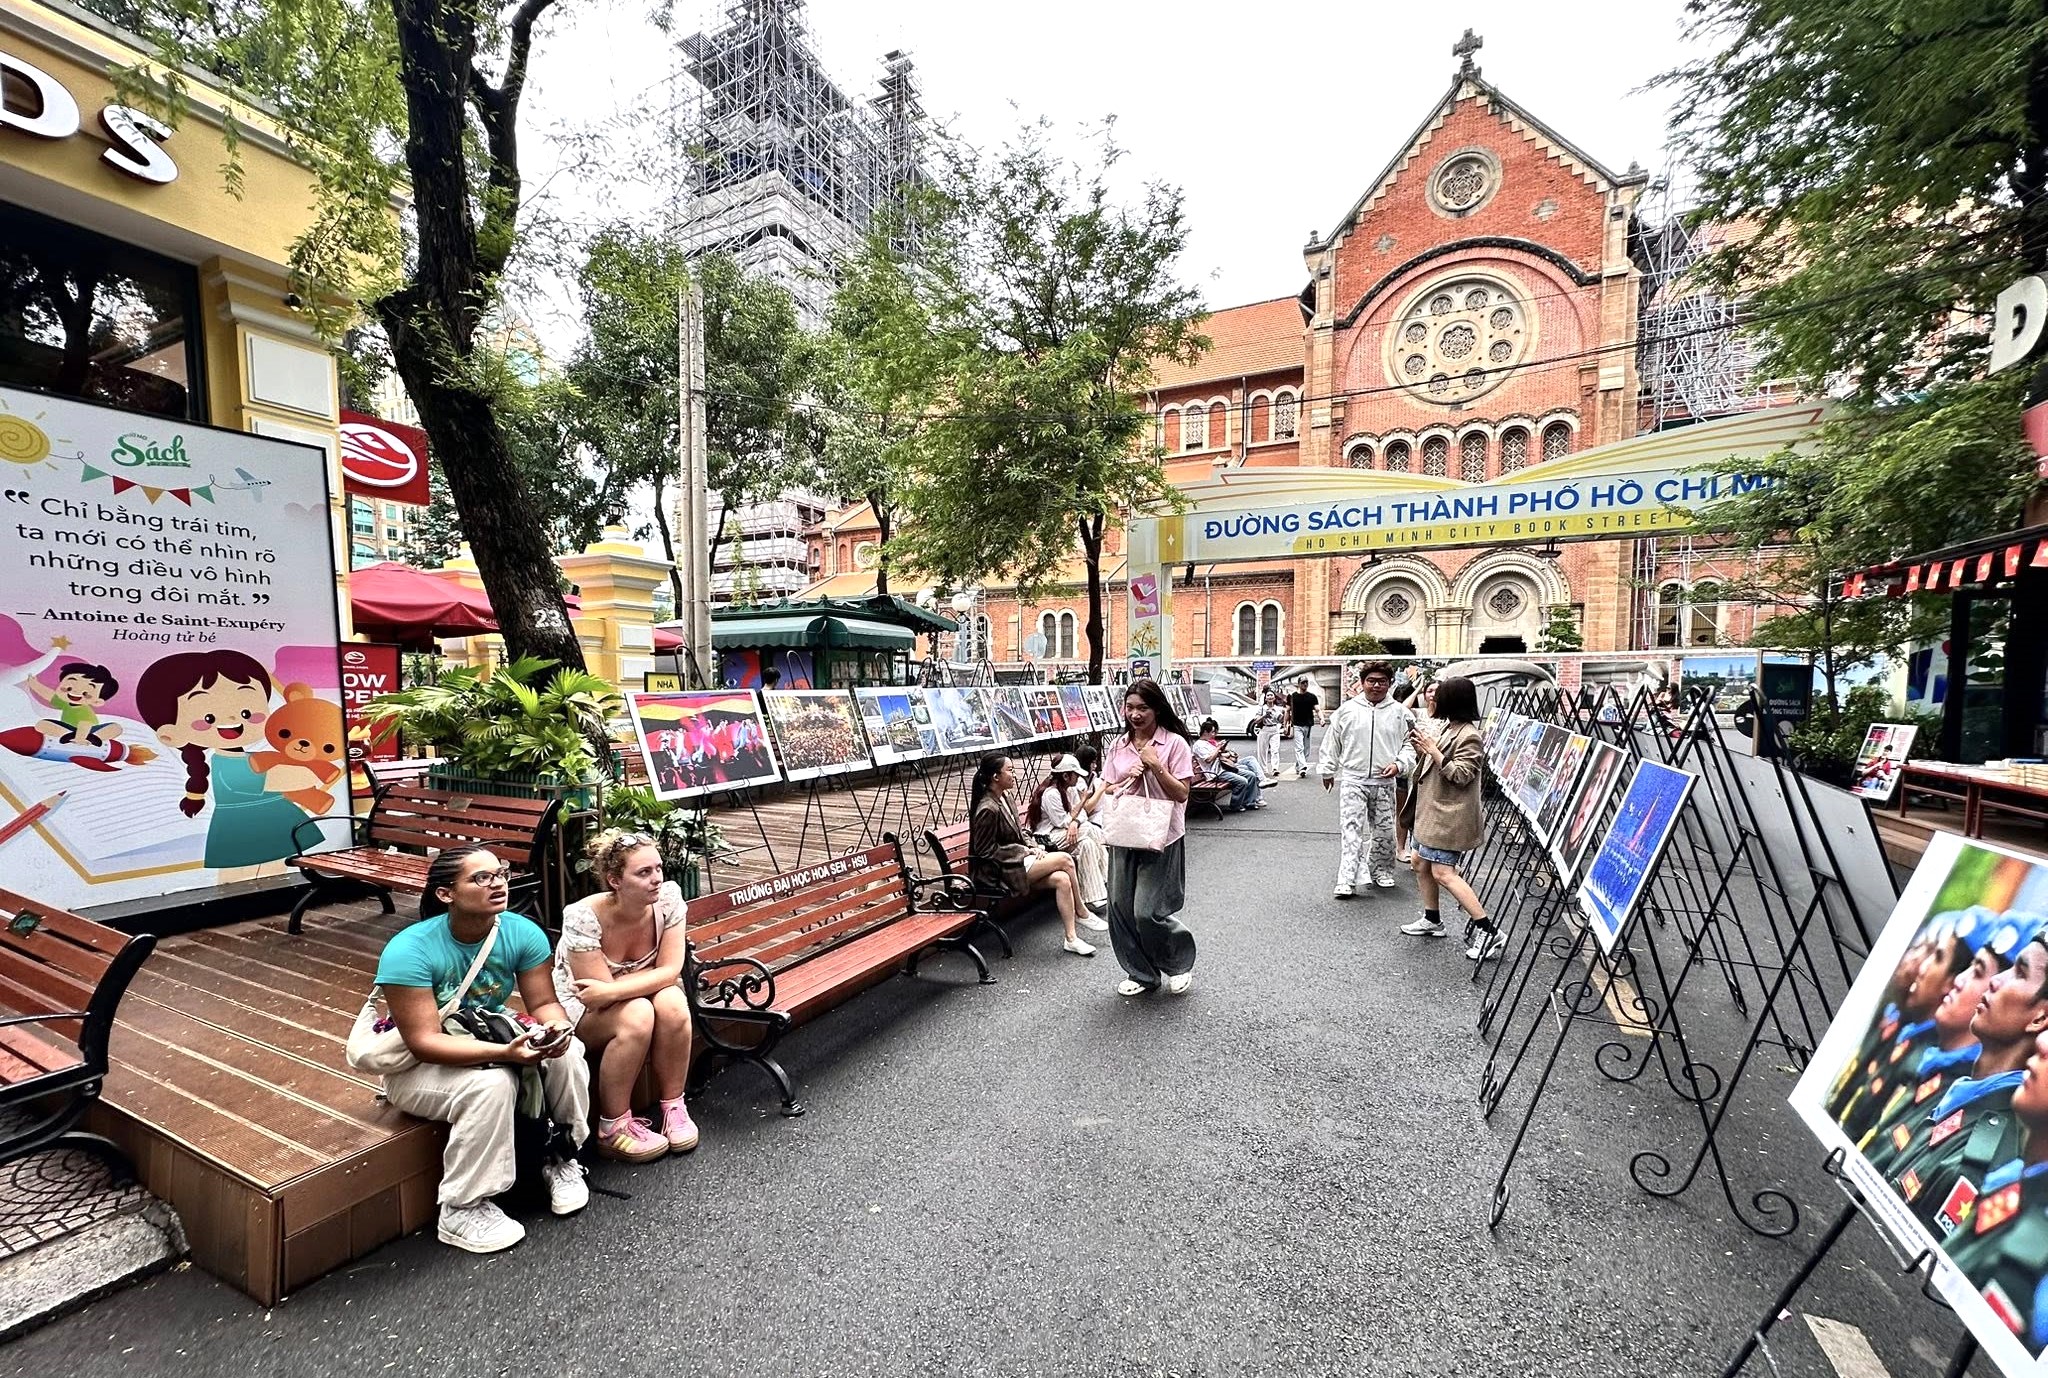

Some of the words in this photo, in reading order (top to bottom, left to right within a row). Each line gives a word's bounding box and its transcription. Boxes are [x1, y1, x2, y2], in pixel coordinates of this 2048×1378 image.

[111, 435, 191, 466] Sách
[41, 498, 88, 519] Chỉ
[98, 503, 163, 532] bằng
[171, 515, 209, 533] trái
[215, 521, 257, 541] tim,
[1204, 513, 1300, 539] ĐƯỜNG
[1308, 504, 1382, 531] SÁCH
[1391, 494, 1498, 524] THÀNH
[1508, 482, 1579, 514] PHỐ
[1591, 478, 1643, 508] HỒ
[16, 524, 44, 541] ta
[55, 527, 106, 547] mới
[116, 532, 146, 551] có
[153, 537, 193, 555] thể
[200, 542, 248, 561] nhìn
[255, 548, 275, 563] rõ
[1306, 538, 1326, 549] HO
[1340, 534, 1370, 547] CHI
[1386, 529, 1433, 543] MINH
[1450, 524, 1495, 539] CITY
[1514, 519, 1567, 534] BOOK
[1586, 511, 1674, 529] STREET
[30, 550, 119, 577] những
[128, 559, 183, 579] điều
[190, 566, 218, 581] vô
[225, 567, 271, 585] hình
[68, 581, 142, 604] trong
[151, 585, 189, 603] đôi
[43, 608, 128, 624] Antoine
[133, 611, 157, 626] de
[162, 613, 286, 632] Saint-Exupéry
[533, 608, 562, 628] 23
[112, 628, 171, 645] Hoàng
[175, 629, 194, 643] tử
[198, 629, 217, 643] bé
[729, 880, 773, 906] TRƯỜNG
[774, 877, 790, 894] ĐẠI
[790, 871, 811, 887] HỌC
[812, 865, 830, 881] HOA
[830, 860, 847, 875] SEN
[853, 854, 868, 869] HSU
